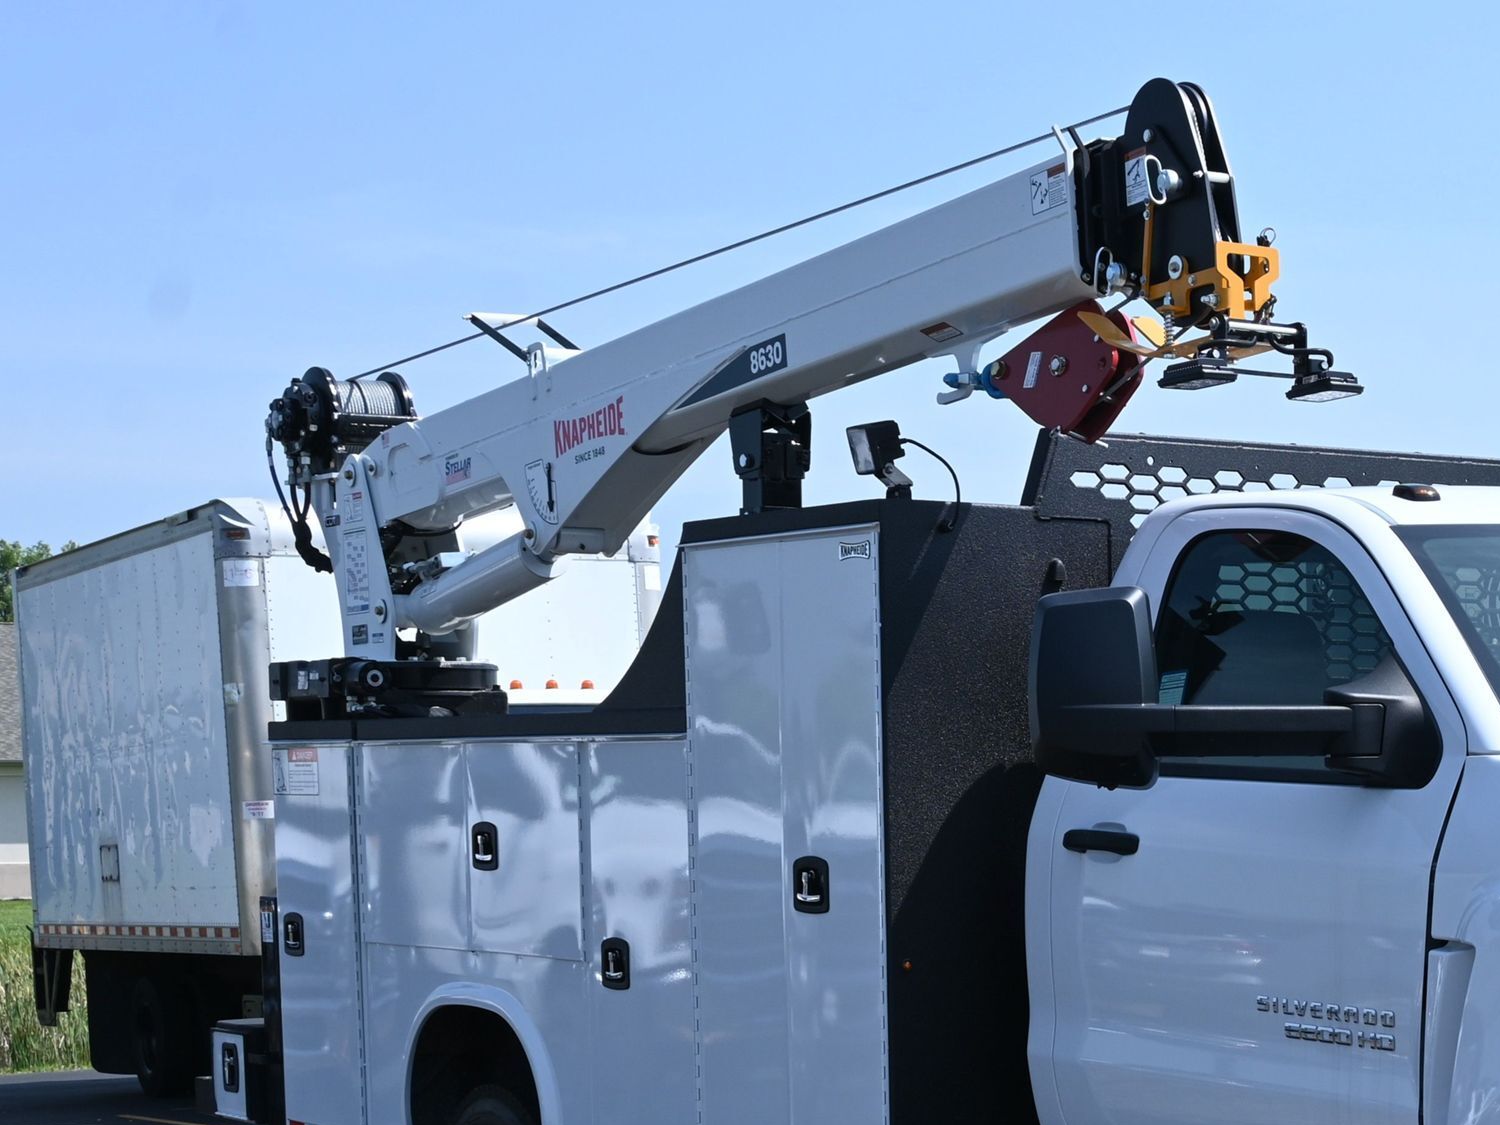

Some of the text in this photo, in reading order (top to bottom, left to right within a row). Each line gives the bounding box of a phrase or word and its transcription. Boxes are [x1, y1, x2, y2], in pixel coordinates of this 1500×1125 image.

[750, 341, 782, 374] 8630
[554, 395, 625, 458] KNAPHEIDE
[445, 457, 471, 476] STELLAR
[575, 446, 606, 465] SINCE 1848
[1256, 995, 1396, 1028] SILVERADO
[1357, 1031, 1396, 1052] HD
